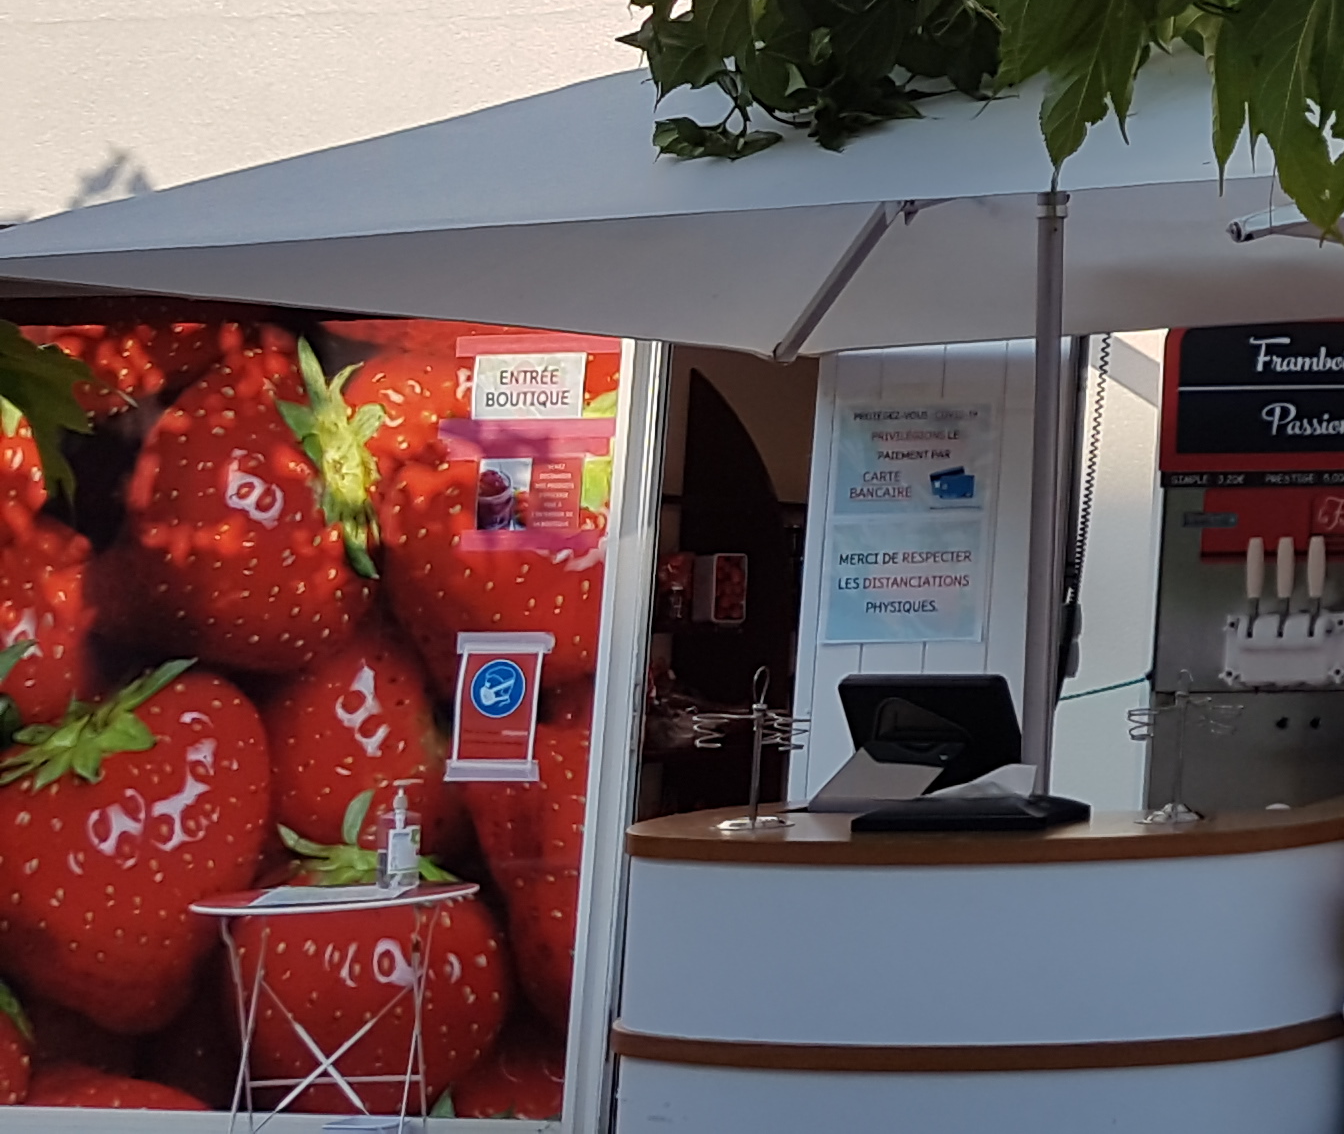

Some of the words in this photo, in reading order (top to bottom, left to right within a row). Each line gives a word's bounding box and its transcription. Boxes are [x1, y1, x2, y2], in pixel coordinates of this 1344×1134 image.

[499, 366, 560, 386] ENTRÉE
[485, 389, 571, 408] BOUTIQUE
[862, 470, 901, 483] CARTE
[850, 485, 912, 499] BANCAIRE
[838, 552, 878, 565] MERCI
[882, 551, 899, 565] DE
[901, 550, 972, 564] RESPECTER
[838, 577, 860, 590] LES
[862, 574, 970, 590] DISTANCIATIONS
